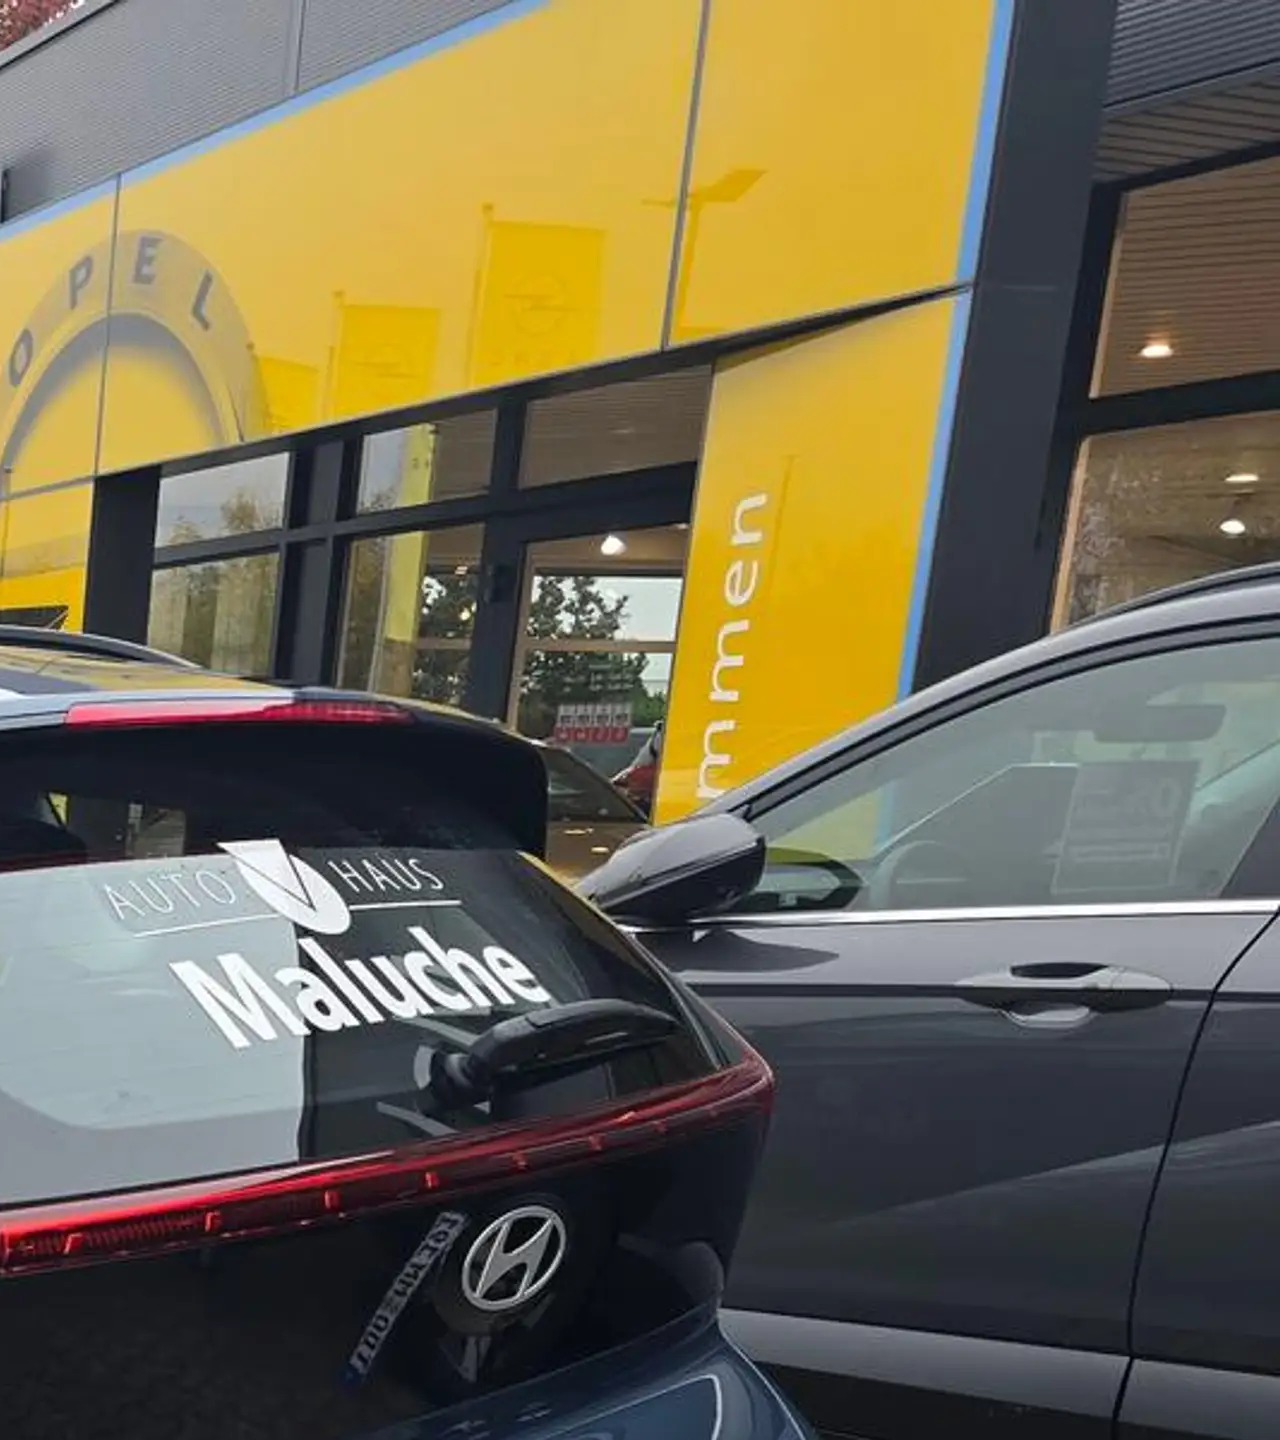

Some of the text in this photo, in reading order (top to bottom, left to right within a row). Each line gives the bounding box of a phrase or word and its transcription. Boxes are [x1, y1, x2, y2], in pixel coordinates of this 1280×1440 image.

[9, 236, 214, 388] OPEL
[104, 857, 445, 921] AUTO HAUS
[169, 926, 552, 1050] Maluche
